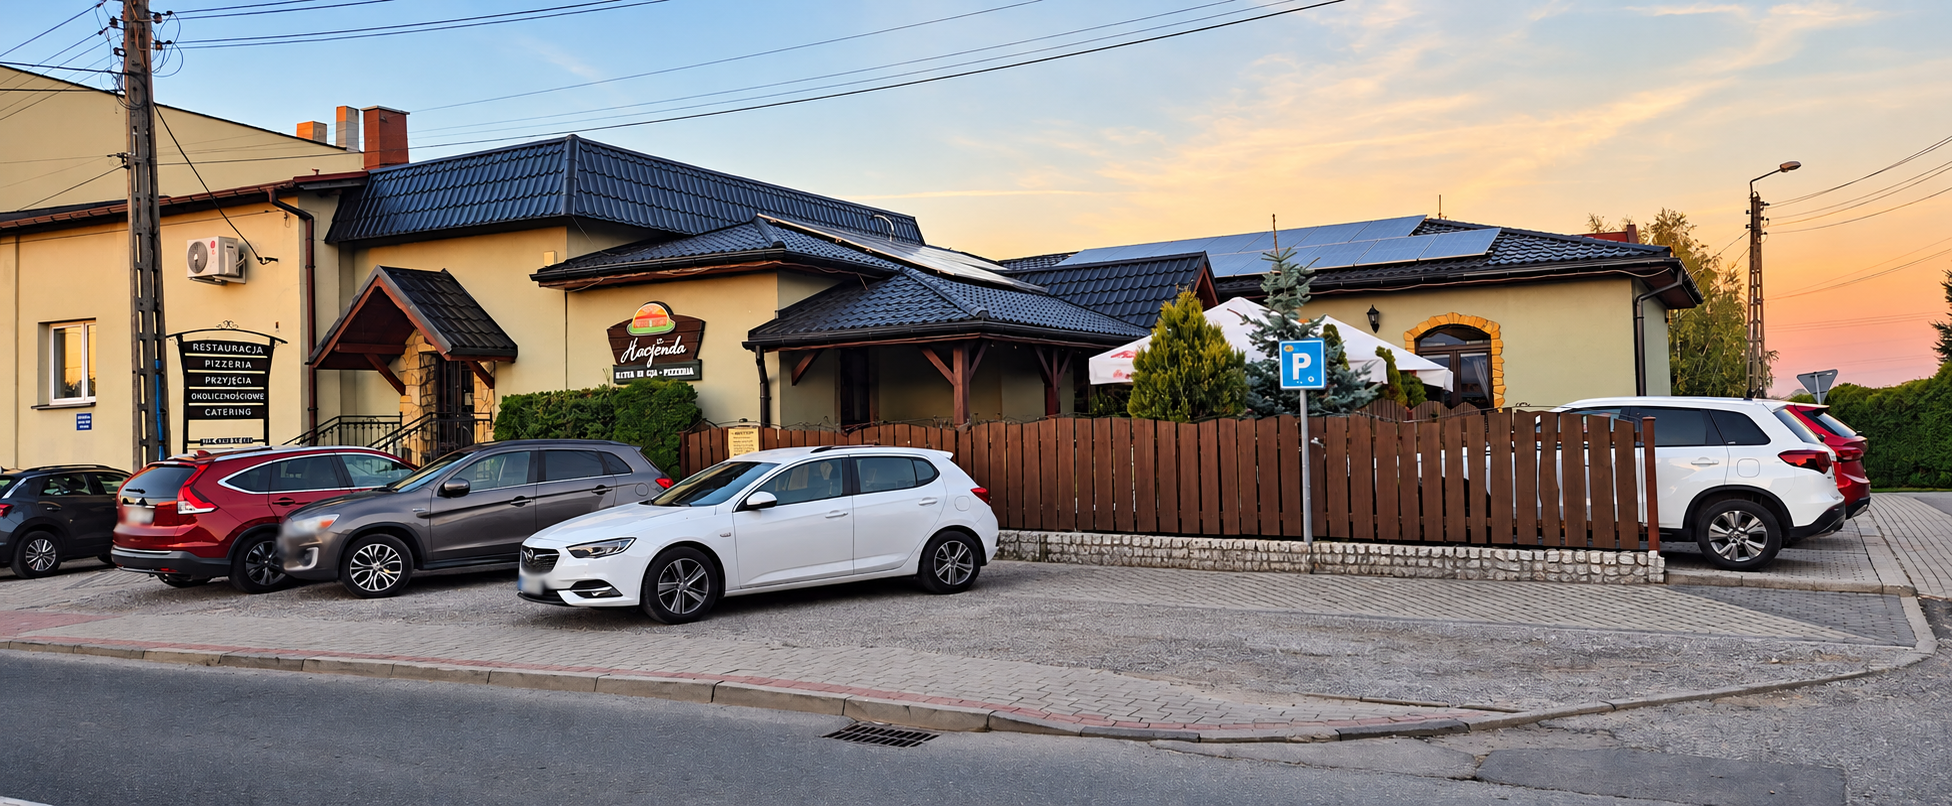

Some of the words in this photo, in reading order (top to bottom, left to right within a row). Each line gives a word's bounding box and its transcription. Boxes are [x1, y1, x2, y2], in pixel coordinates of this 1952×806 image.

[192, 343, 264, 354] RESTAURACJA
[204, 359, 252, 369] PIZZERIA
[1292, 352, 1312, 381] P
[204, 376, 252, 386] PRZYJĘCIA
[191, 391, 265, 400] OKOLICZNOŚCIOWE
[204, 408, 252, 416] CATERING
